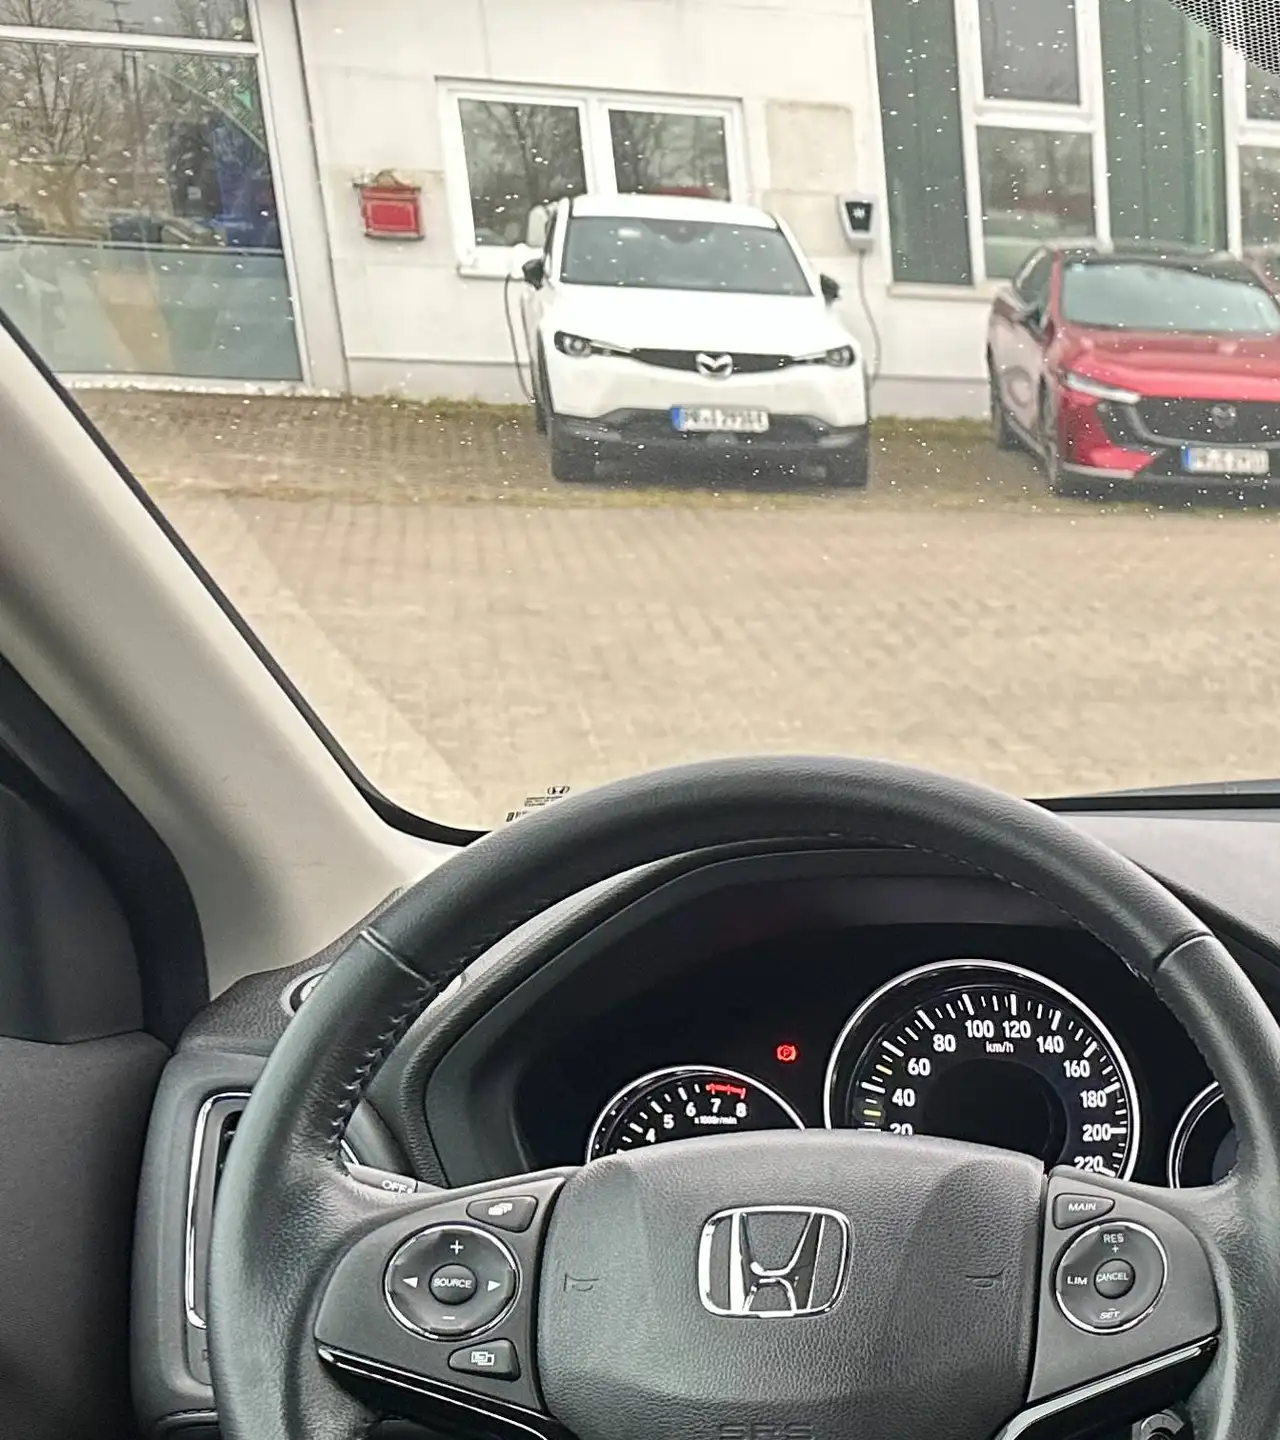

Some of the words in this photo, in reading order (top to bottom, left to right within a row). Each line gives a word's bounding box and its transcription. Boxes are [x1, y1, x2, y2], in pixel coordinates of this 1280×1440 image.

[965, 1020, 995, 1039] 100
[1002, 1020, 1031, 1039] 120
[933, 1034, 956, 1053] 80
[985, 1041, 1014, 1054] km/h
[1036, 1036, 1065, 1054] 140
[907, 1057, 931, 1077] 60
[1063, 1059, 1091, 1078] 160
[891, 1088, 916, 1107] 40
[1080, 1090, 1107, 1109] 180
[685, 1102, 697, 1118] 6
[711, 1098, 722, 1114] 7
[735, 1102, 748, 1118] 8
[663, 1114, 675, 1130] 5
[645, 1128, 657, 1144] 4
[1082, 1124, 1112, 1142] 200
[1068, 1202, 1097, 1212] MAIN
[1103, 1233, 1125, 1244] RES
[433, 1276, 473, 1290] SOURCE
[1067, 1276, 1089, 1286] LIM
[1096, 1271, 1129, 1283] CANCEL
